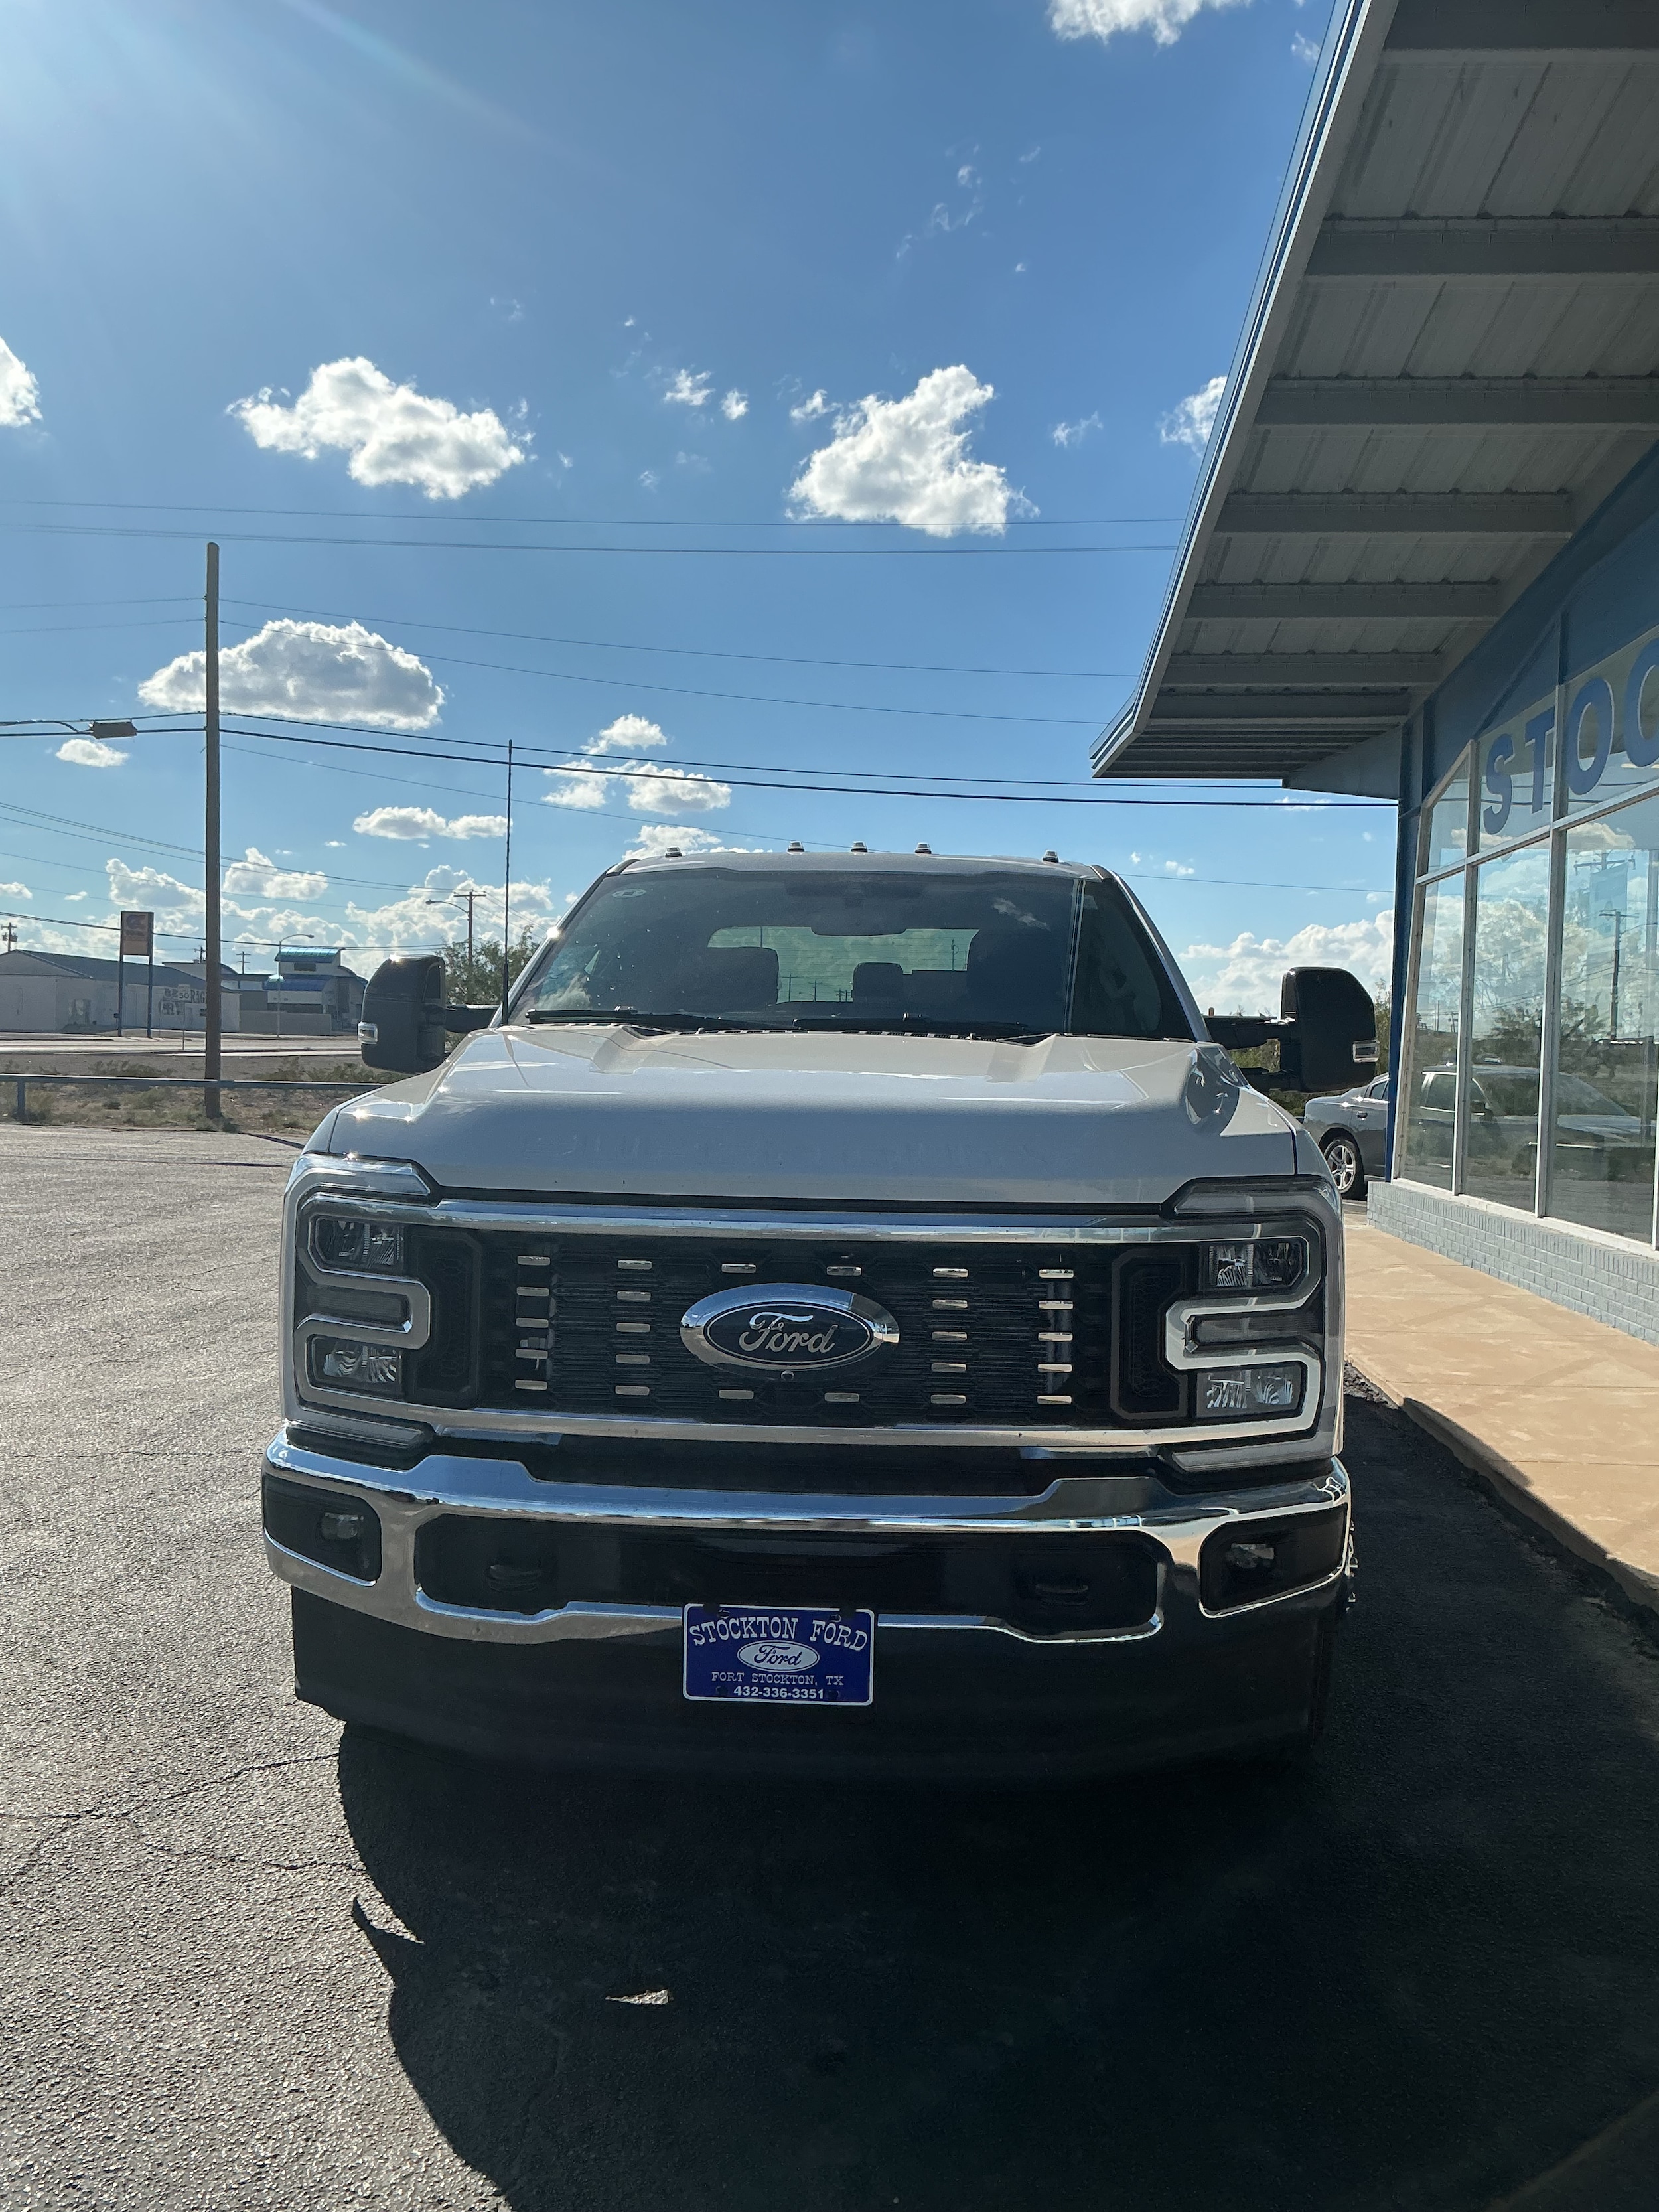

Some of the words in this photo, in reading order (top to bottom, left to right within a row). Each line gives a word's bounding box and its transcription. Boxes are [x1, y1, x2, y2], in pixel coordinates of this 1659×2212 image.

[739, 1311, 838, 1353] Ford
[689, 1616, 799, 1646] STOCKTON
[810, 1619, 868, 1651] FORD
[754, 1645, 802, 1666] Ford
[711, 1672, 744, 1682] FORT
[826, 1675, 844, 1686] TX
[733, 1686, 824, 1699] 432-336-3351
